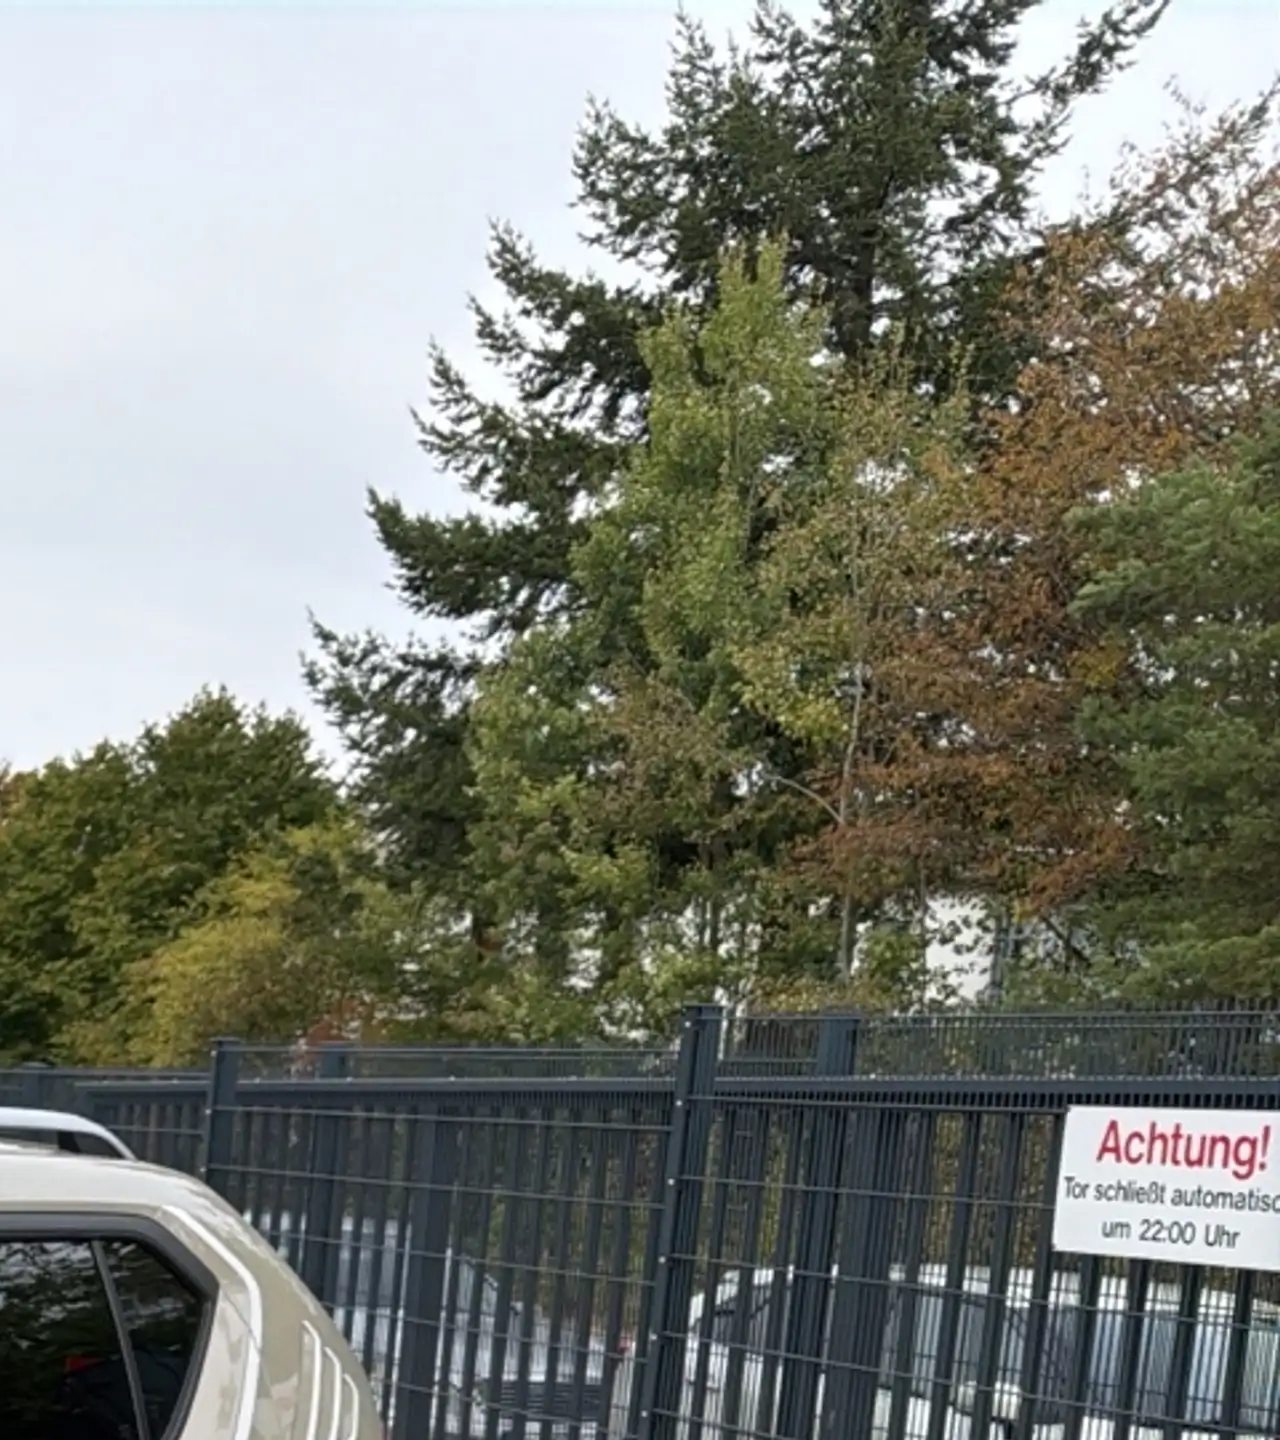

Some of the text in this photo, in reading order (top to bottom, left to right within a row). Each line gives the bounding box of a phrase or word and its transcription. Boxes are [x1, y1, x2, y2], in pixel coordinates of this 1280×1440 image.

[1096, 1119, 1271, 1180] Achtung!
[1064, 1176, 1090, 1199] Tor
[1093, 1179, 1166, 1205] schließt
[1101, 1219, 1241, 1249] um 22:00 Uhr
